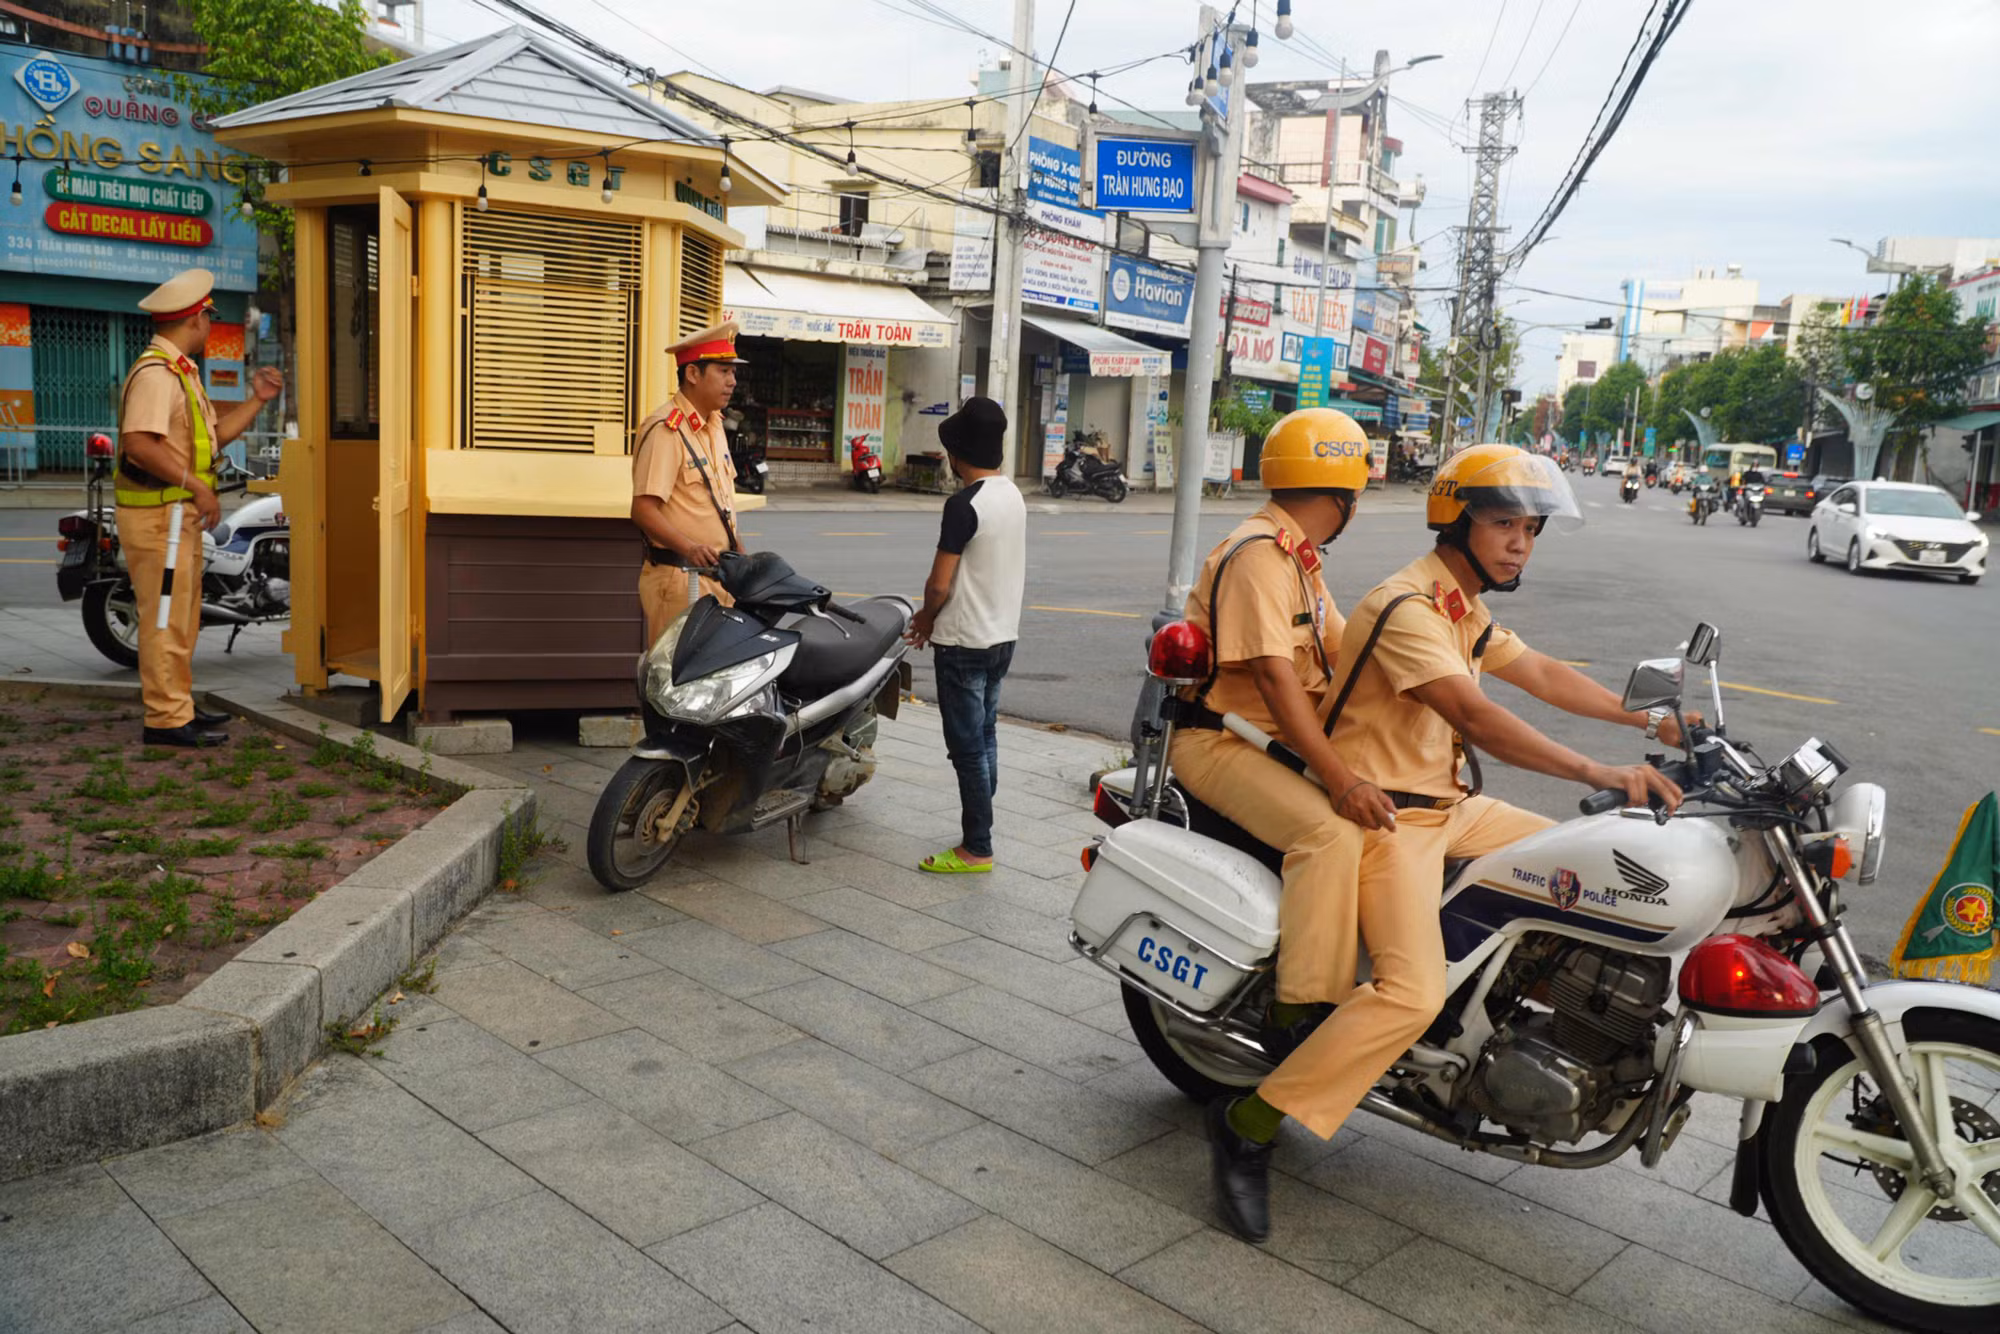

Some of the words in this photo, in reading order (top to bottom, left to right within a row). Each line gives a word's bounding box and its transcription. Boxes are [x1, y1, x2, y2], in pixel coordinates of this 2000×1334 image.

[84, 93, 179, 127] QUẢNG
[0, 113, 123, 169] HỒNG
[137, 142, 250, 183] SANG
[1029, 151, 1060, 172] PHÒNG
[1116, 146, 1172, 168] ĐƯỜNG
[488, 151, 627, 191] CSGT
[72, 175, 97, 198] MÀU
[99, 179, 127, 202] TRÊN
[129, 186, 151, 208] MỌI
[152, 185, 180, 211] CHẤT
[181, 192, 204, 214] LIỆU
[1102, 170, 1130, 196] TRẦN
[1132, 175, 1161, 198] HƯNG
[1162, 177, 1184, 203] ĐẠO
[60, 207, 88, 231] CẮT
[91, 213, 137, 236] DECAL
[141, 215, 166, 239] LẤY
[7, 235, 32, 249] 334
[1135, 276, 1183, 306] Havian
[876, 321, 912, 341] TOÀN
[847, 397, 881, 430] TOÀN
[1314, 441, 1364, 457] CSGT
[1512, 867, 1547, 888] TRAFFIC
[1583, 889, 1617, 907] POLICE
[1604, 886, 1669, 906] HONDA
[1138, 937, 1209, 989] CSGT
